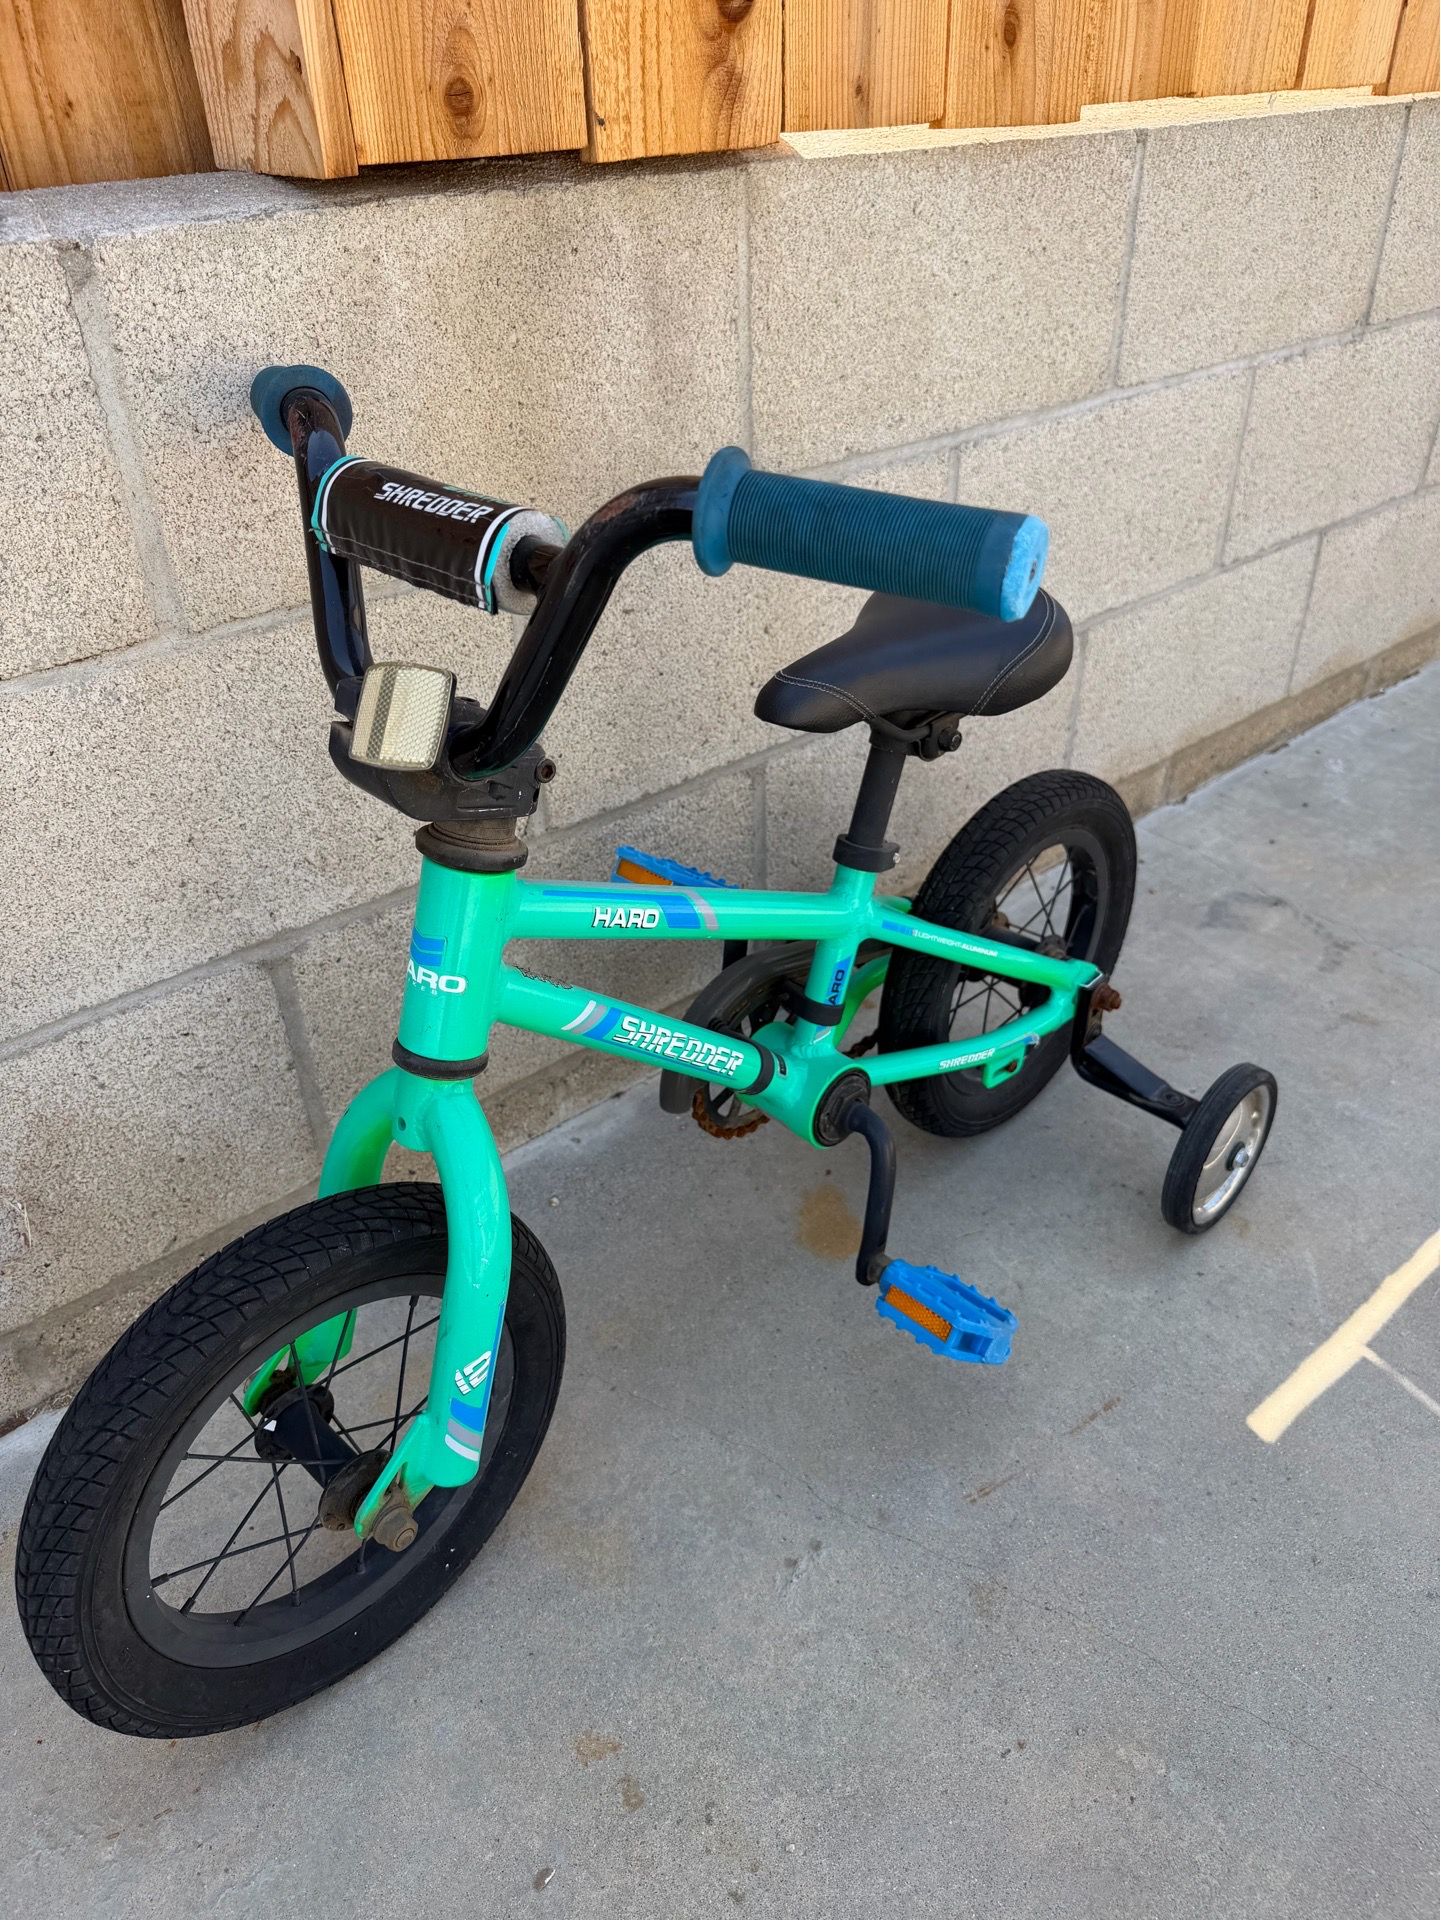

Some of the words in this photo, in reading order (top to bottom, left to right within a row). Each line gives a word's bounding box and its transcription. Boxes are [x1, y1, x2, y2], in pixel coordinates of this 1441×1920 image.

[373, 481, 494, 524] SHREDDER
[591, 905, 660, 929] HARO
[406, 958, 467, 994] ARO
[828, 969, 845, 1005] ARO
[612, 1015, 745, 1077] SHREDDER
[940, 1047, 996, 1070] SHREDDER
